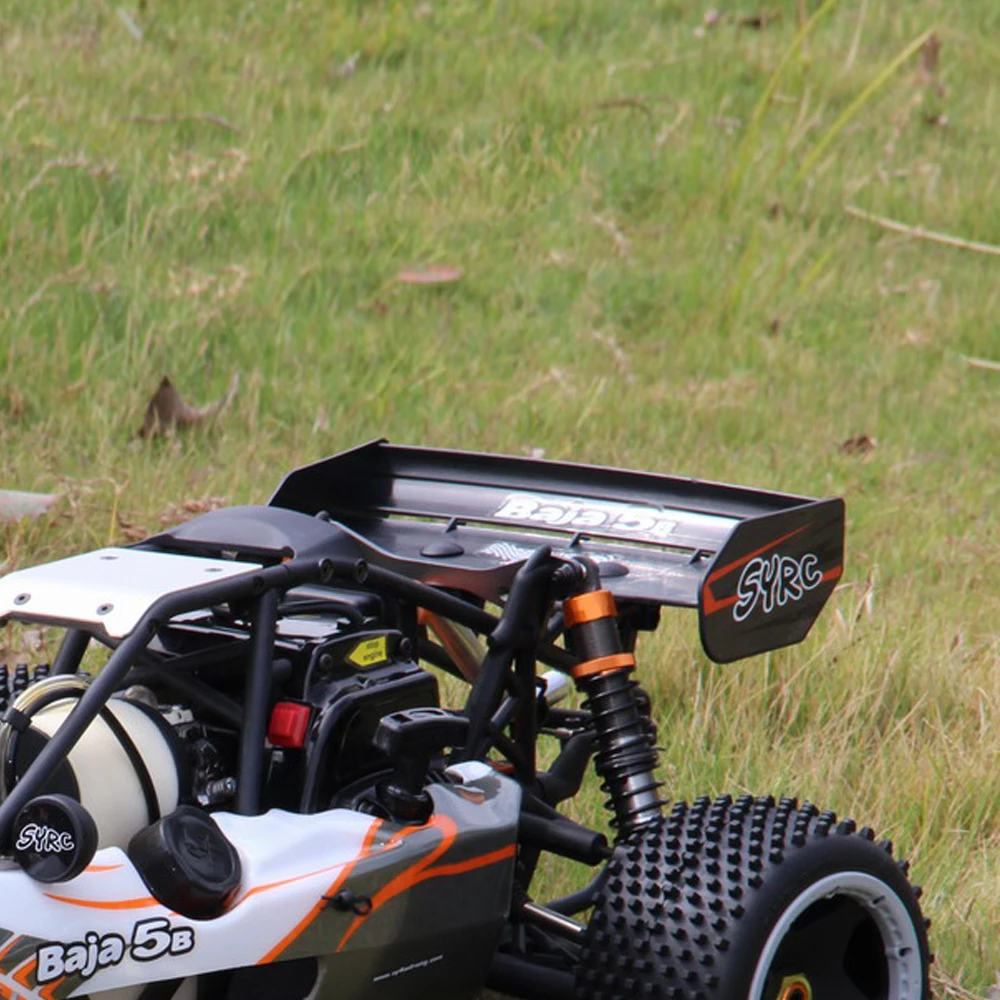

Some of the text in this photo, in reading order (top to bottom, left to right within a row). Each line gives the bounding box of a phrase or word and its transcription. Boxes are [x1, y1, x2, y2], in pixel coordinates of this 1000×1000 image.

[494, 494, 608, 527] Baja
[733, 553, 823, 622] SYRC
[15, 822, 75, 853] SYRC
[37, 917, 195, 986] Baja 5B
